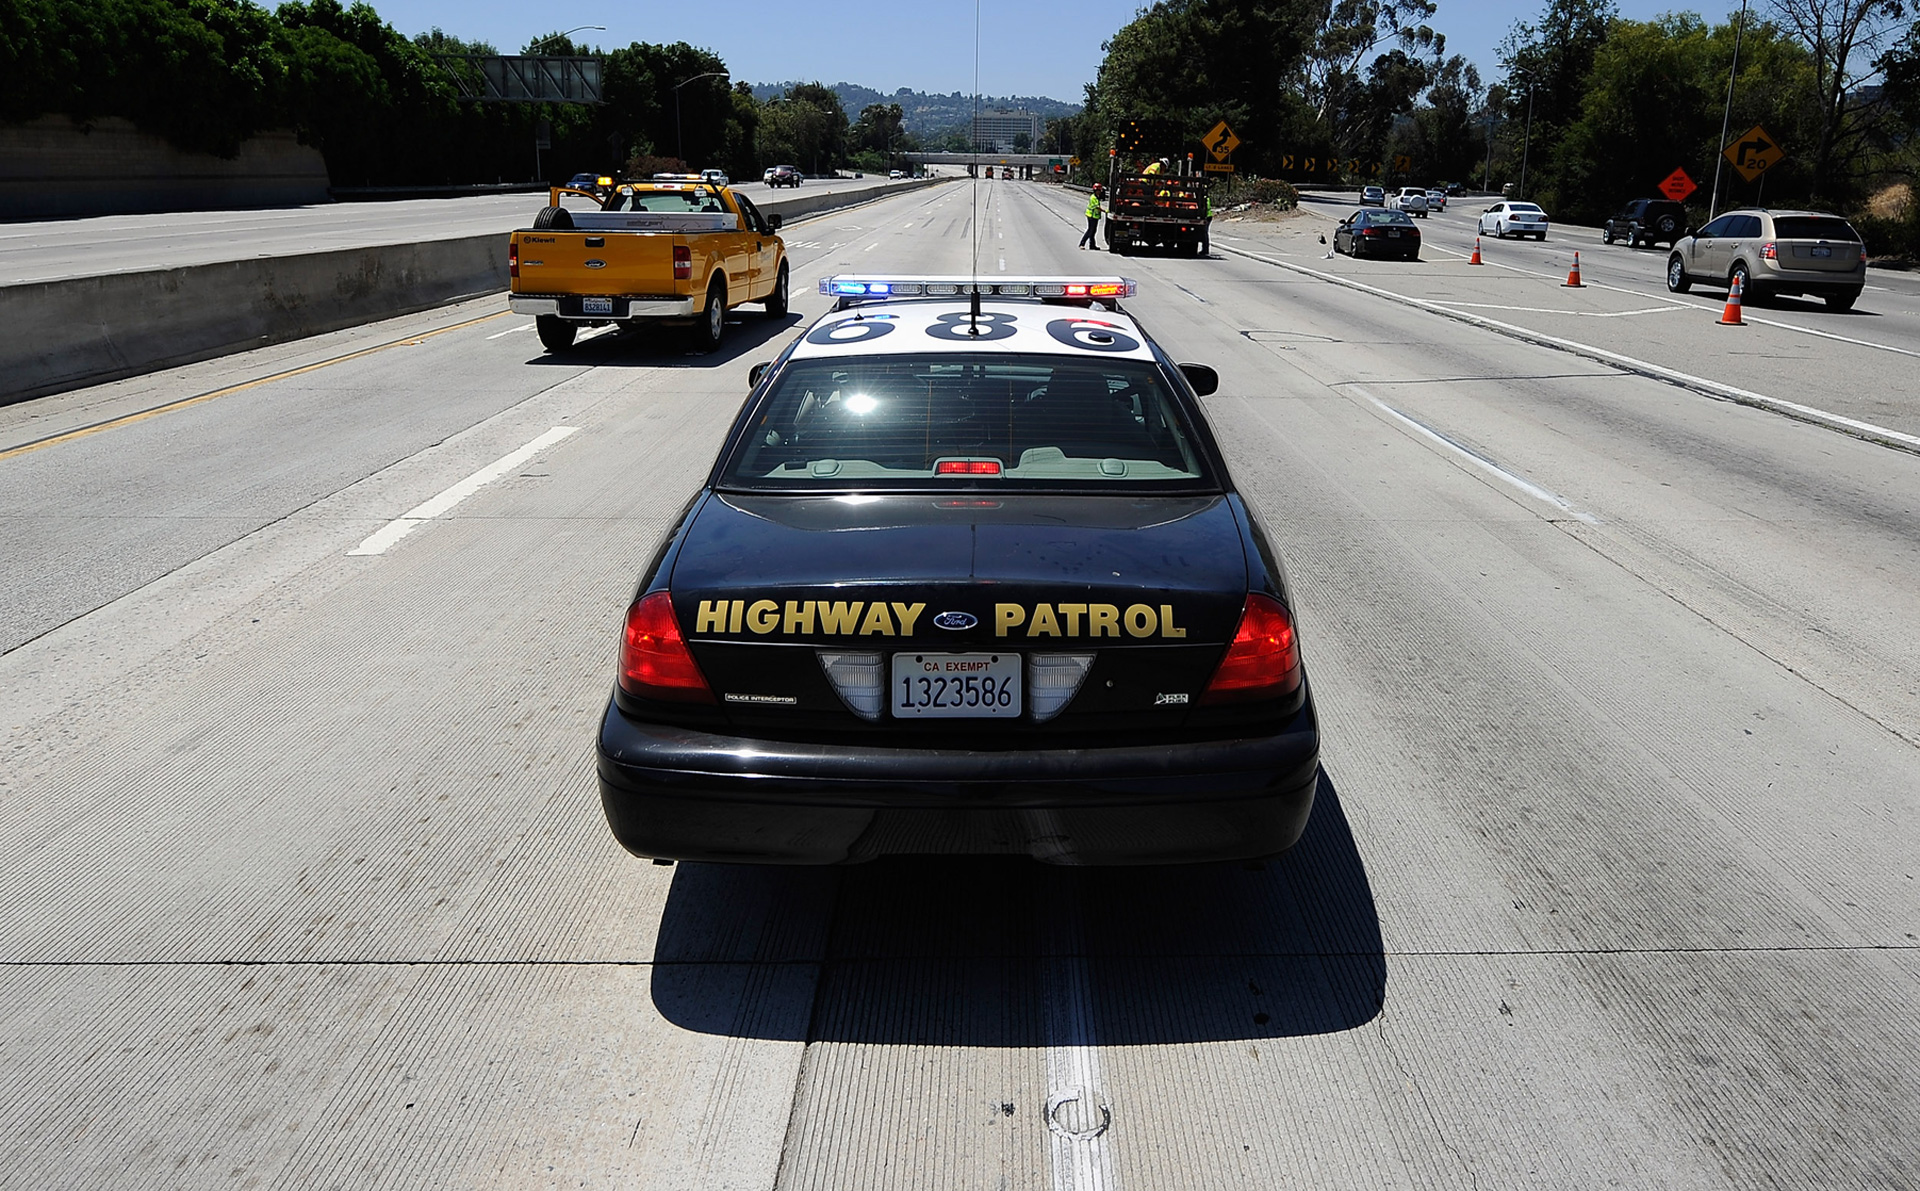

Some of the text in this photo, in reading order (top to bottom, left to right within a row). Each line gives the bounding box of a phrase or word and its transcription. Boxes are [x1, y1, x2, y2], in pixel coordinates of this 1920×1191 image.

[1217, 145, 1230, 154] 35
[1746, 158, 1767, 170] 20
[695, 600, 1187, 639] HIGHWAY PATROL
[923, 661, 991, 672] CA EXEMPT
[901, 676, 1012, 708] 1323586
[750, 695, 794, 703] INTERCEPTOR
